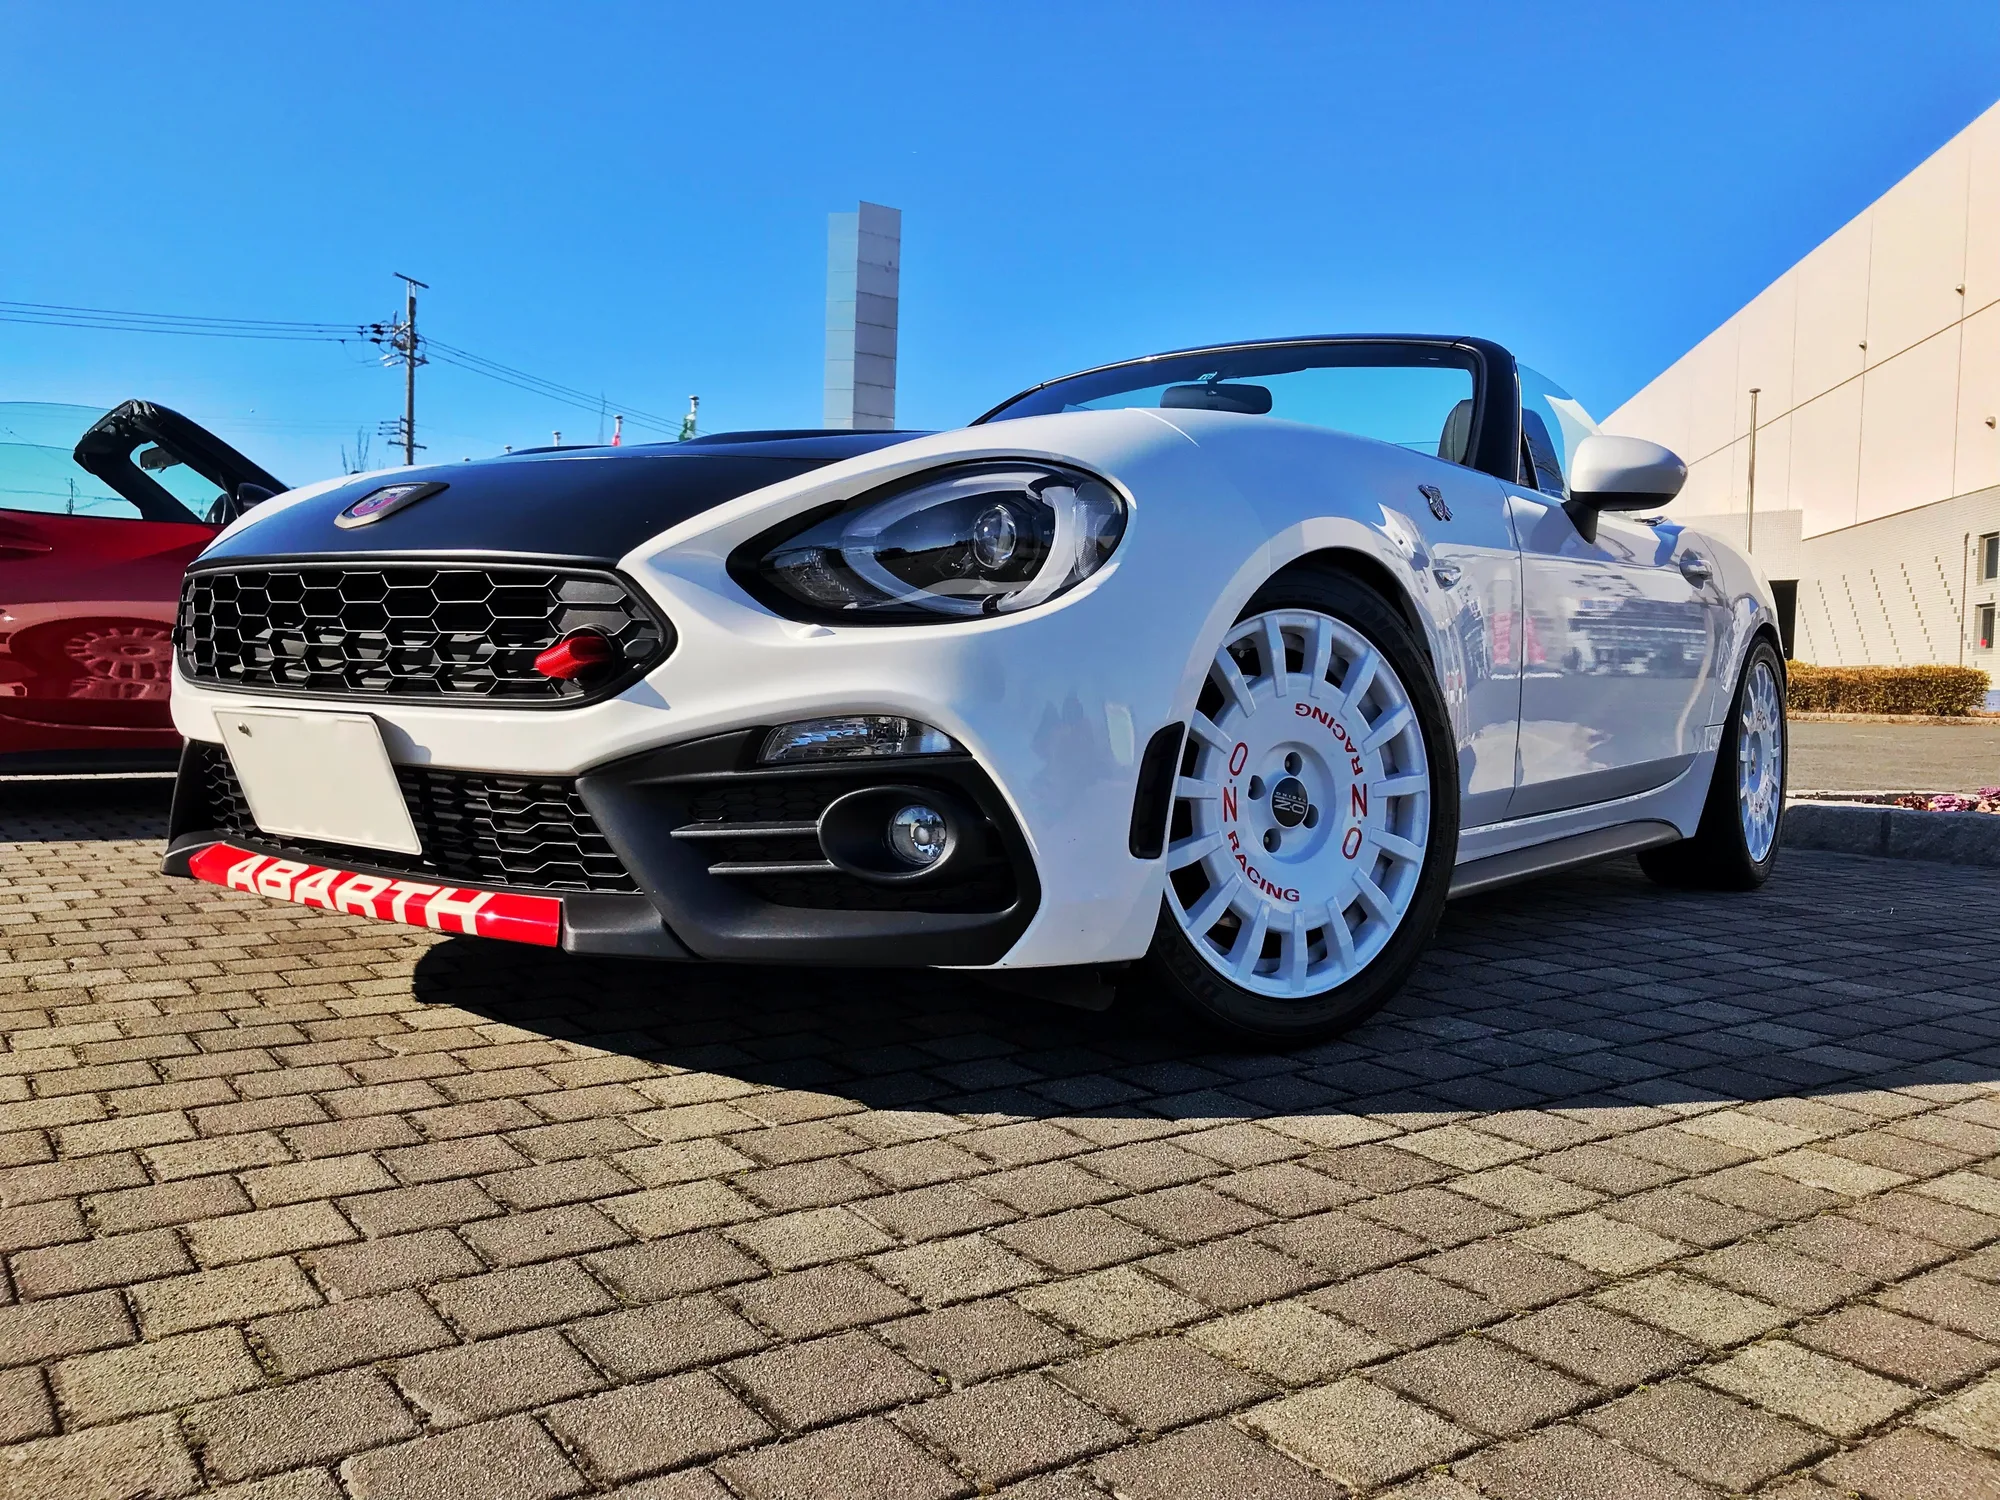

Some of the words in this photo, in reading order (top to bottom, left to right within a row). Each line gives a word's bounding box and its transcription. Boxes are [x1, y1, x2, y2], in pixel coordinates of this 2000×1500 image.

[1294, 703, 1364, 776] RACING
[226, 854, 495, 935] ABARTH
[1228, 830, 1301, 902] RACING
